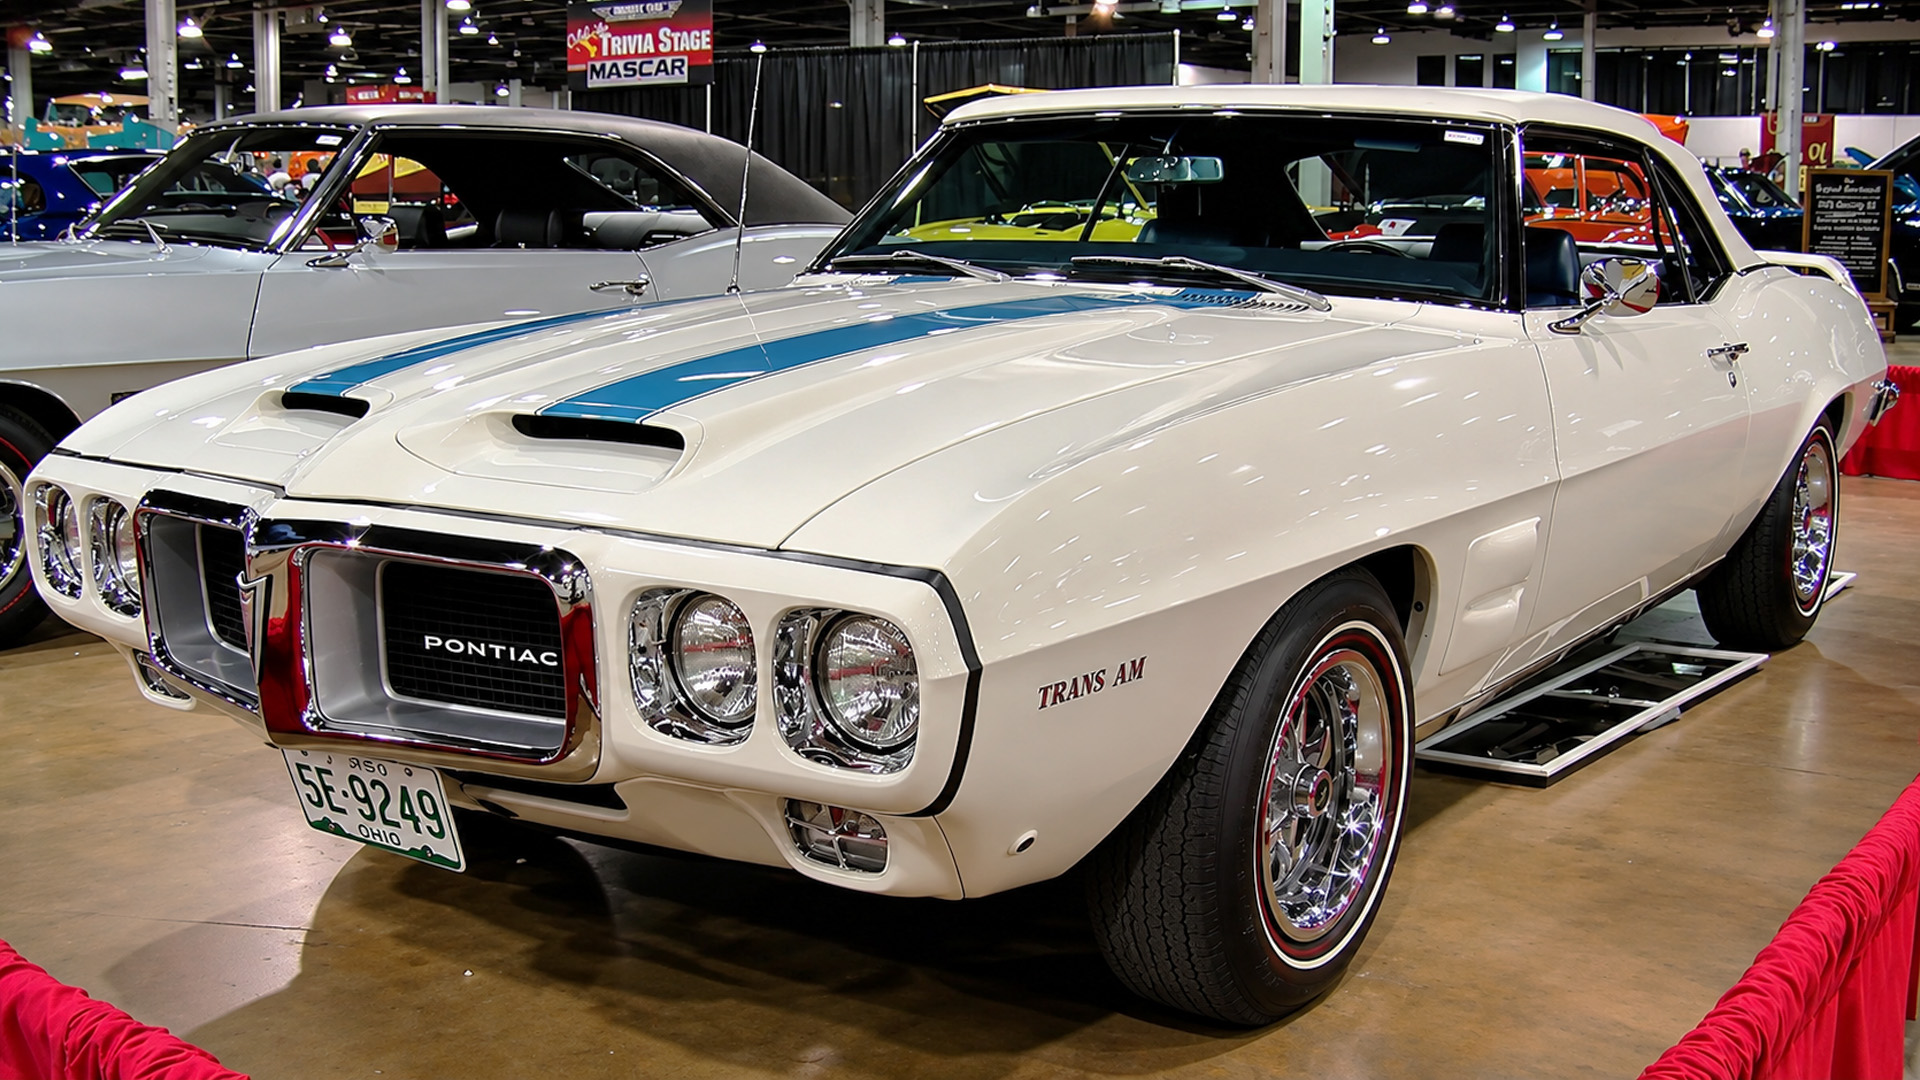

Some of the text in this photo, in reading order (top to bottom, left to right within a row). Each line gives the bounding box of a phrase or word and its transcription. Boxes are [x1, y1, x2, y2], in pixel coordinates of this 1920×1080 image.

[600, 32, 655, 57] TRIVIA
[658, 27, 712, 53] STAGE
[589, 58, 686, 80] MASCAR
[424, 635, 558, 666] PONTIAC
[1038, 656, 1148, 710] TRANS AM
[358, 823, 402, 846] OHIO
